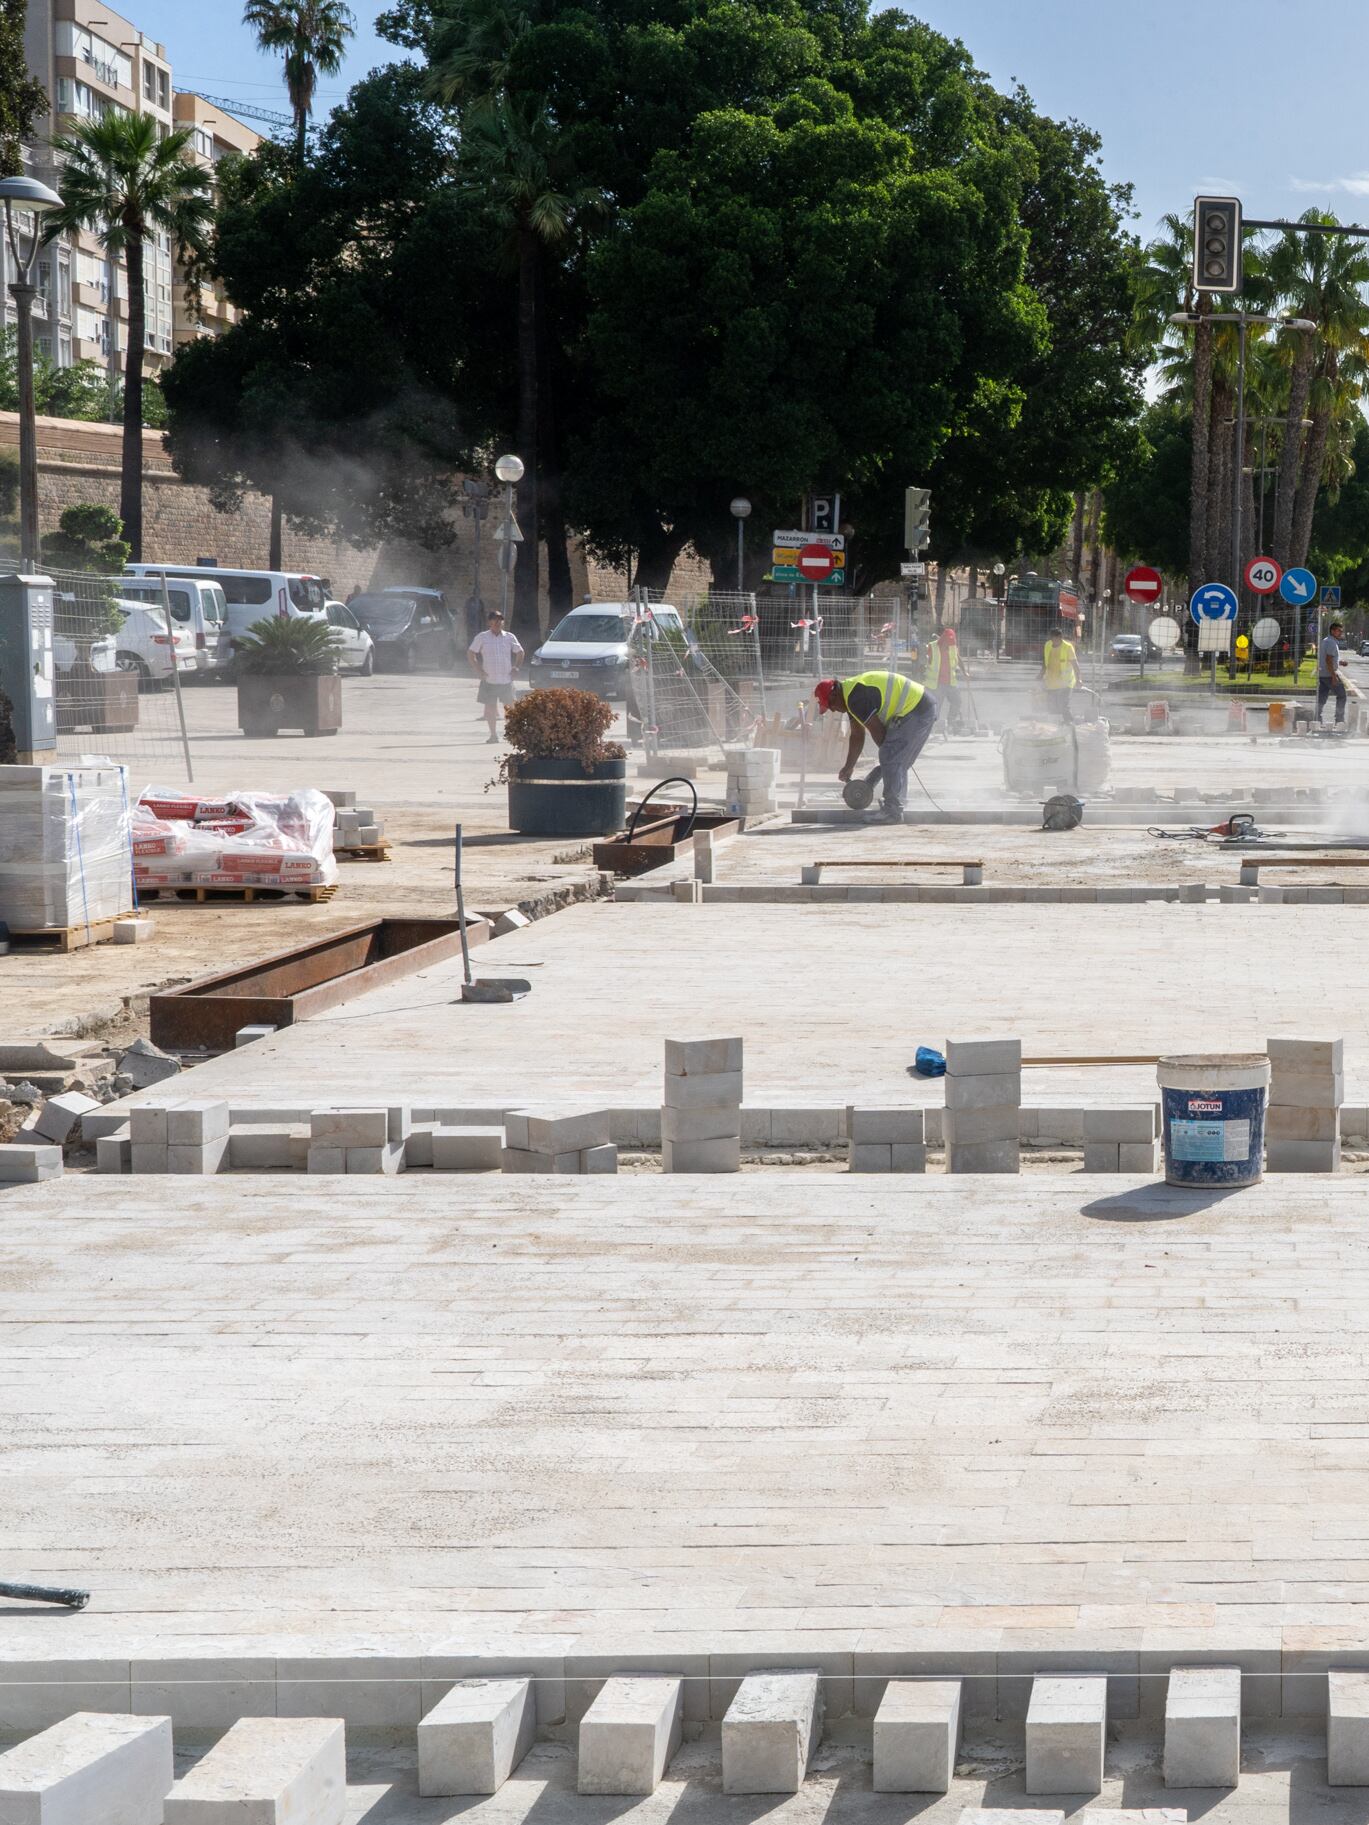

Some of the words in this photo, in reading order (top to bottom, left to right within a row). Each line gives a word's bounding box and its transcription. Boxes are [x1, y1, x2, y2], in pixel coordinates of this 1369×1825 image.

[815, 500, 830, 529] P
[1253, 568, 1273, 583] 40
[200, 806, 225, 814] LANKO
